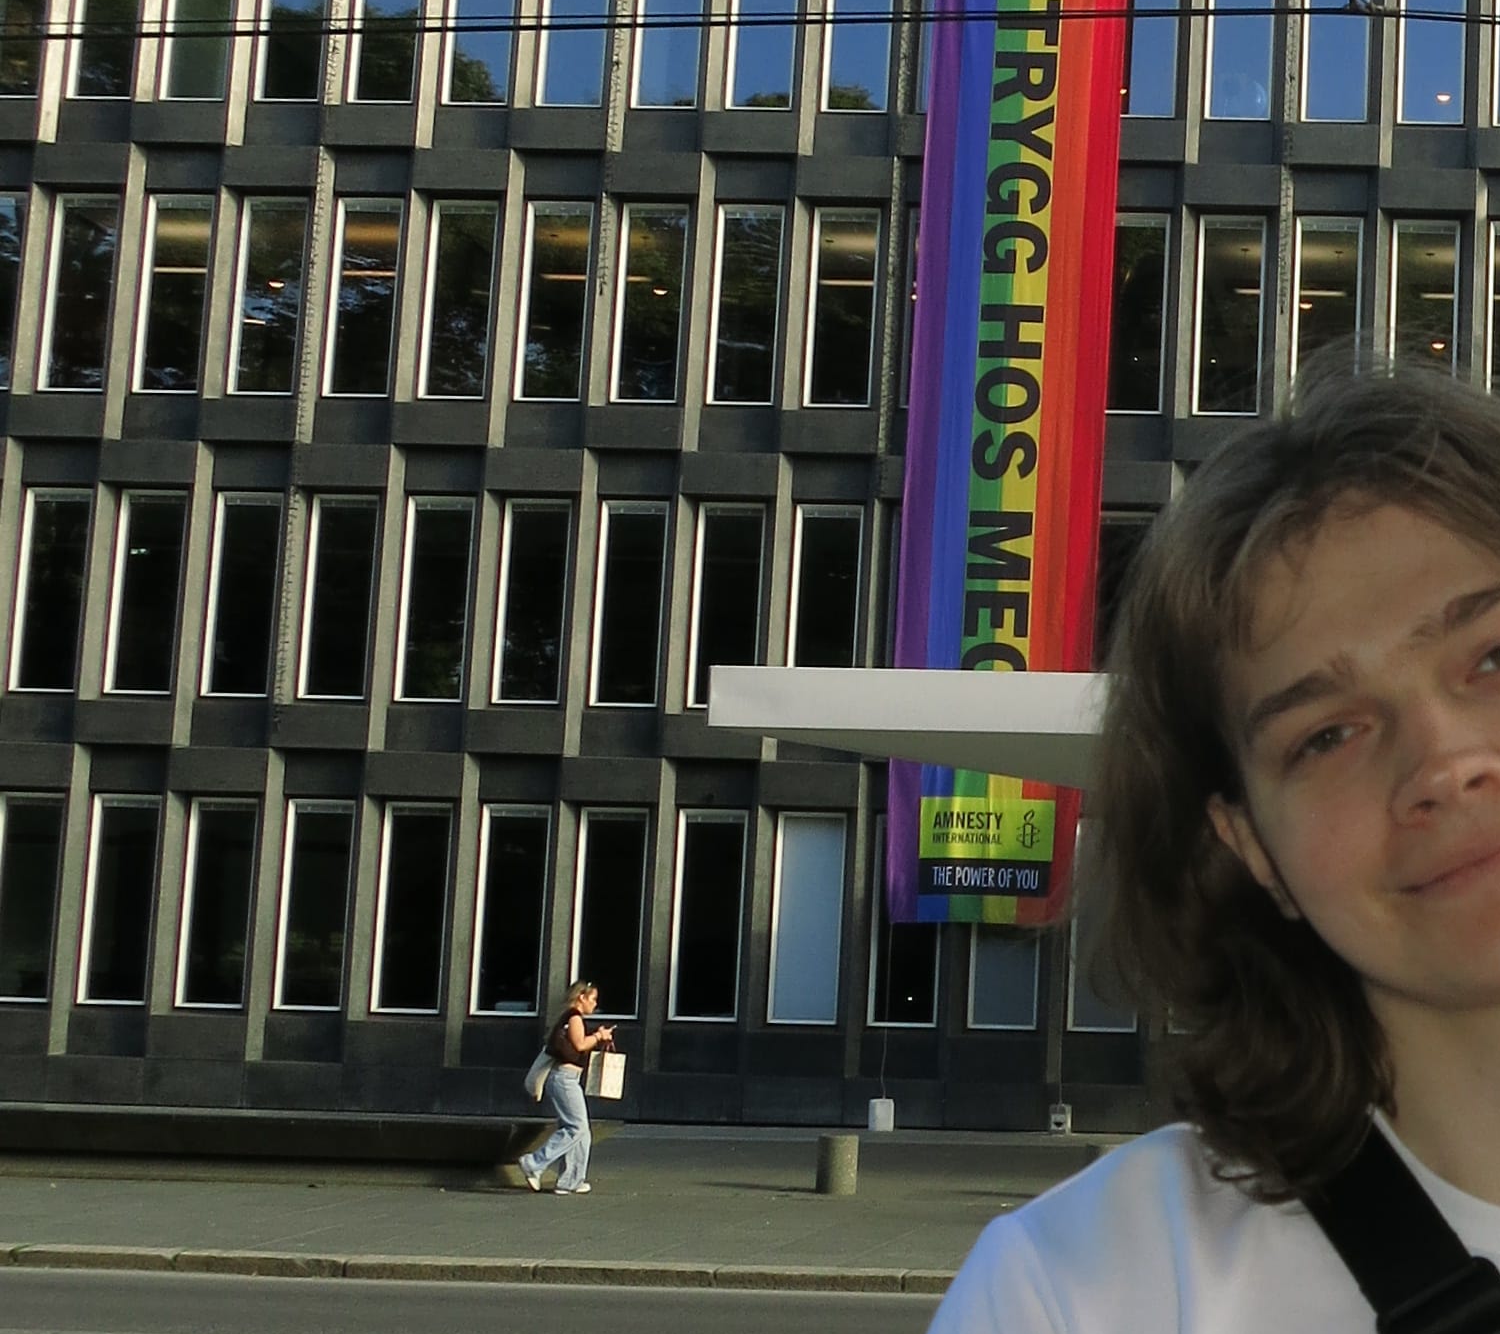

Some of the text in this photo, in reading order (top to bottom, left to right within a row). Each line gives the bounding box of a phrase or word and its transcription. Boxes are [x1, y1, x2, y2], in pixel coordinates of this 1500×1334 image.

[972, 304, 1044, 481] HOS
[933, 811, 1003, 829] AMNESTY
[932, 832, 1002, 845] INTERNATIONAL
[933, 866, 1039, 890] THE POWER OF YOU
